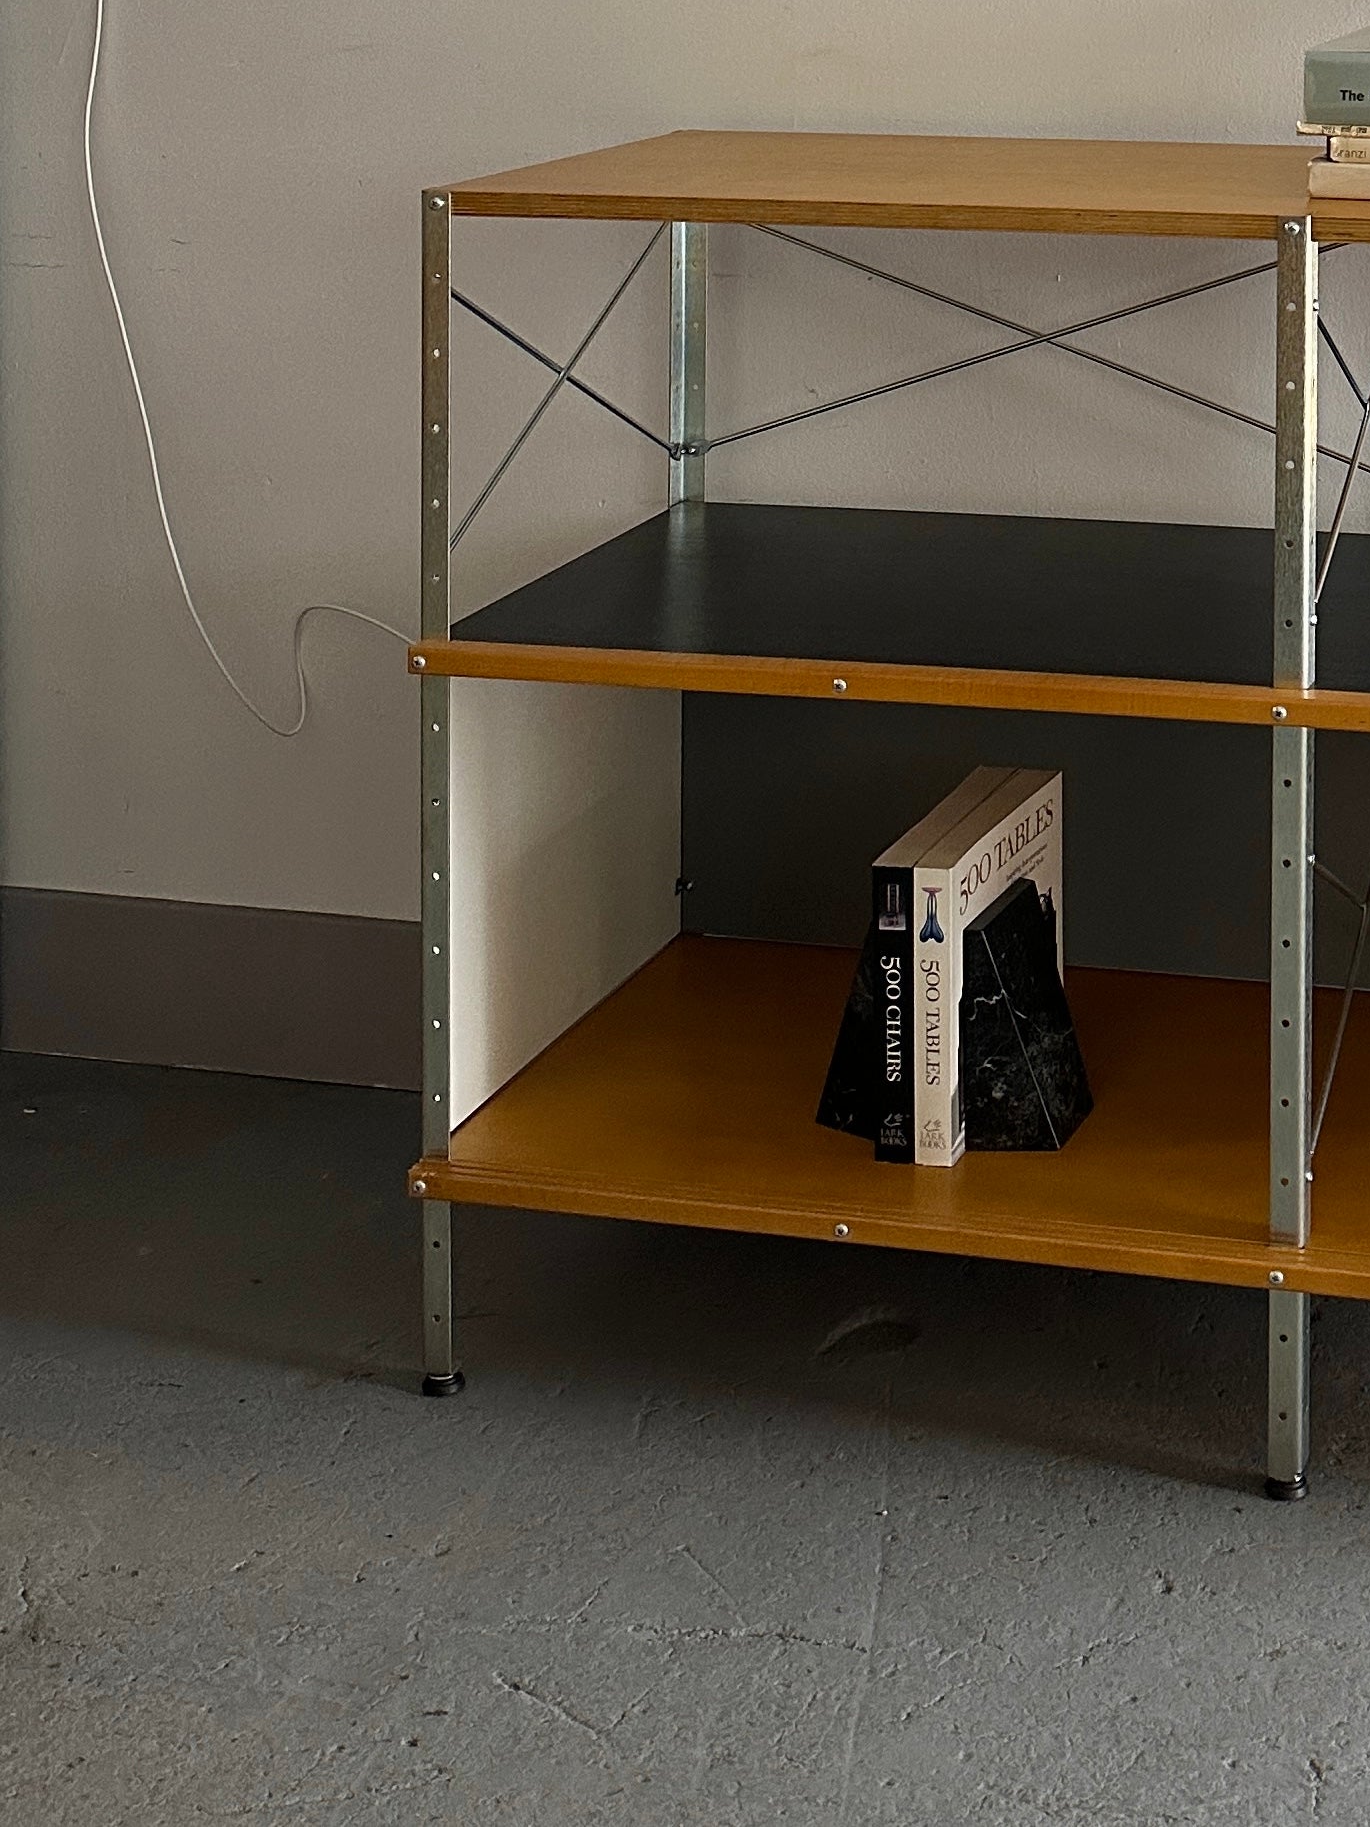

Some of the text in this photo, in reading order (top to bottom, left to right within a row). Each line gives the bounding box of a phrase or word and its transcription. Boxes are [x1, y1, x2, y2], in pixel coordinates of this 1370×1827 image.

[1340, 89, 1365, 103] The
[959, 852, 992, 916] 500
[993, 798, 1054, 872] TABLES
[880, 955, 902, 1082] 500 CHAIRS
[919, 959, 941, 1086] 500 TABLES
